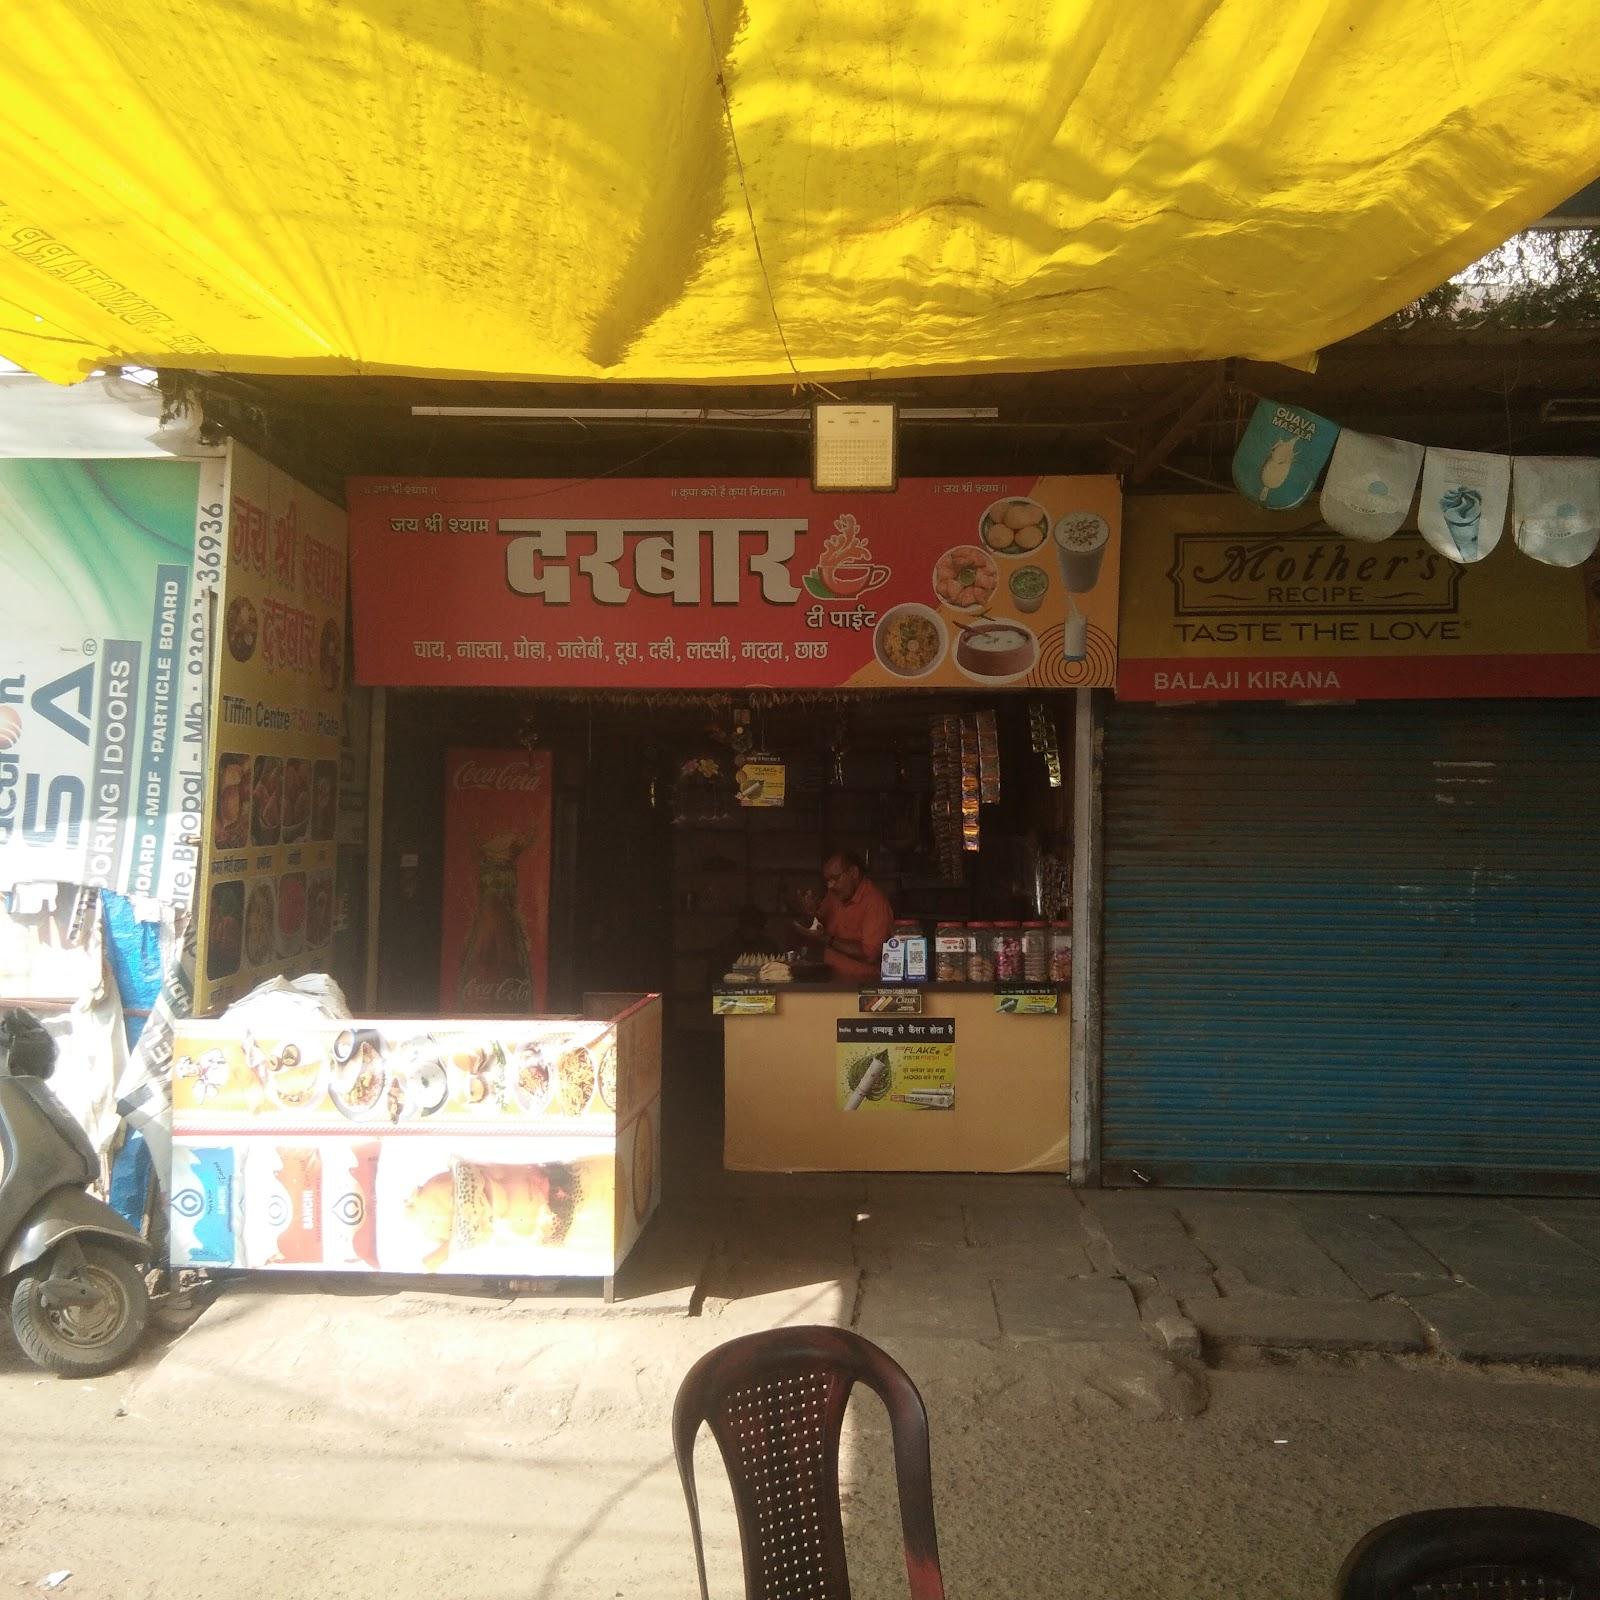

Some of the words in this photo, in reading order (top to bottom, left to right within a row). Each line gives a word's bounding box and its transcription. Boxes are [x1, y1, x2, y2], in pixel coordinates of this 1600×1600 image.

[1272, 416, 1313, 441] MASALA
[1276, 407, 1317, 434] GUAVA
[975, 484, 1000, 493] श्याम
[390, 518, 420, 533] जय
[424, 512, 443, 533] श्री
[448, 518, 489, 533] श्याम
[498, 517, 809, 605] दरबार
[1194, 543, 1440, 585] Mother's
[1266, 586, 1364, 603] RECIPE
[159, 580, 179, 650] BOARD
[806, 604, 824, 628] टी
[1174, 622, 1282, 642] TASTE
[1286, 621, 1360, 641] THE
[1370, 621, 1461, 640] LOVE
[413, 640, 452, 662] चाय,
[513, 635, 552, 662] पोहा,
[556, 636, 610, 662] जलेबी,
[614, 641, 644, 665] दूध,
[648, 637, 681, 664] दही,
[686, 636, 737, 663] लस्सी,
[794, 641, 829, 659] छाछ
[1153, 671, 1241, 691] BALAJI
[1246, 670, 1341, 690] KIRANA
[104, 659, 131, 764] DOORS
[151, 657, 172, 753] PARTICLE
[222, 695, 253, 726] Tiffin
[255, 701, 290, 731] Centre
[145, 771, 162, 816] MDF
[929, 1024, 944, 1034] होता
[903, 1045, 937, 1055] FLAKE
